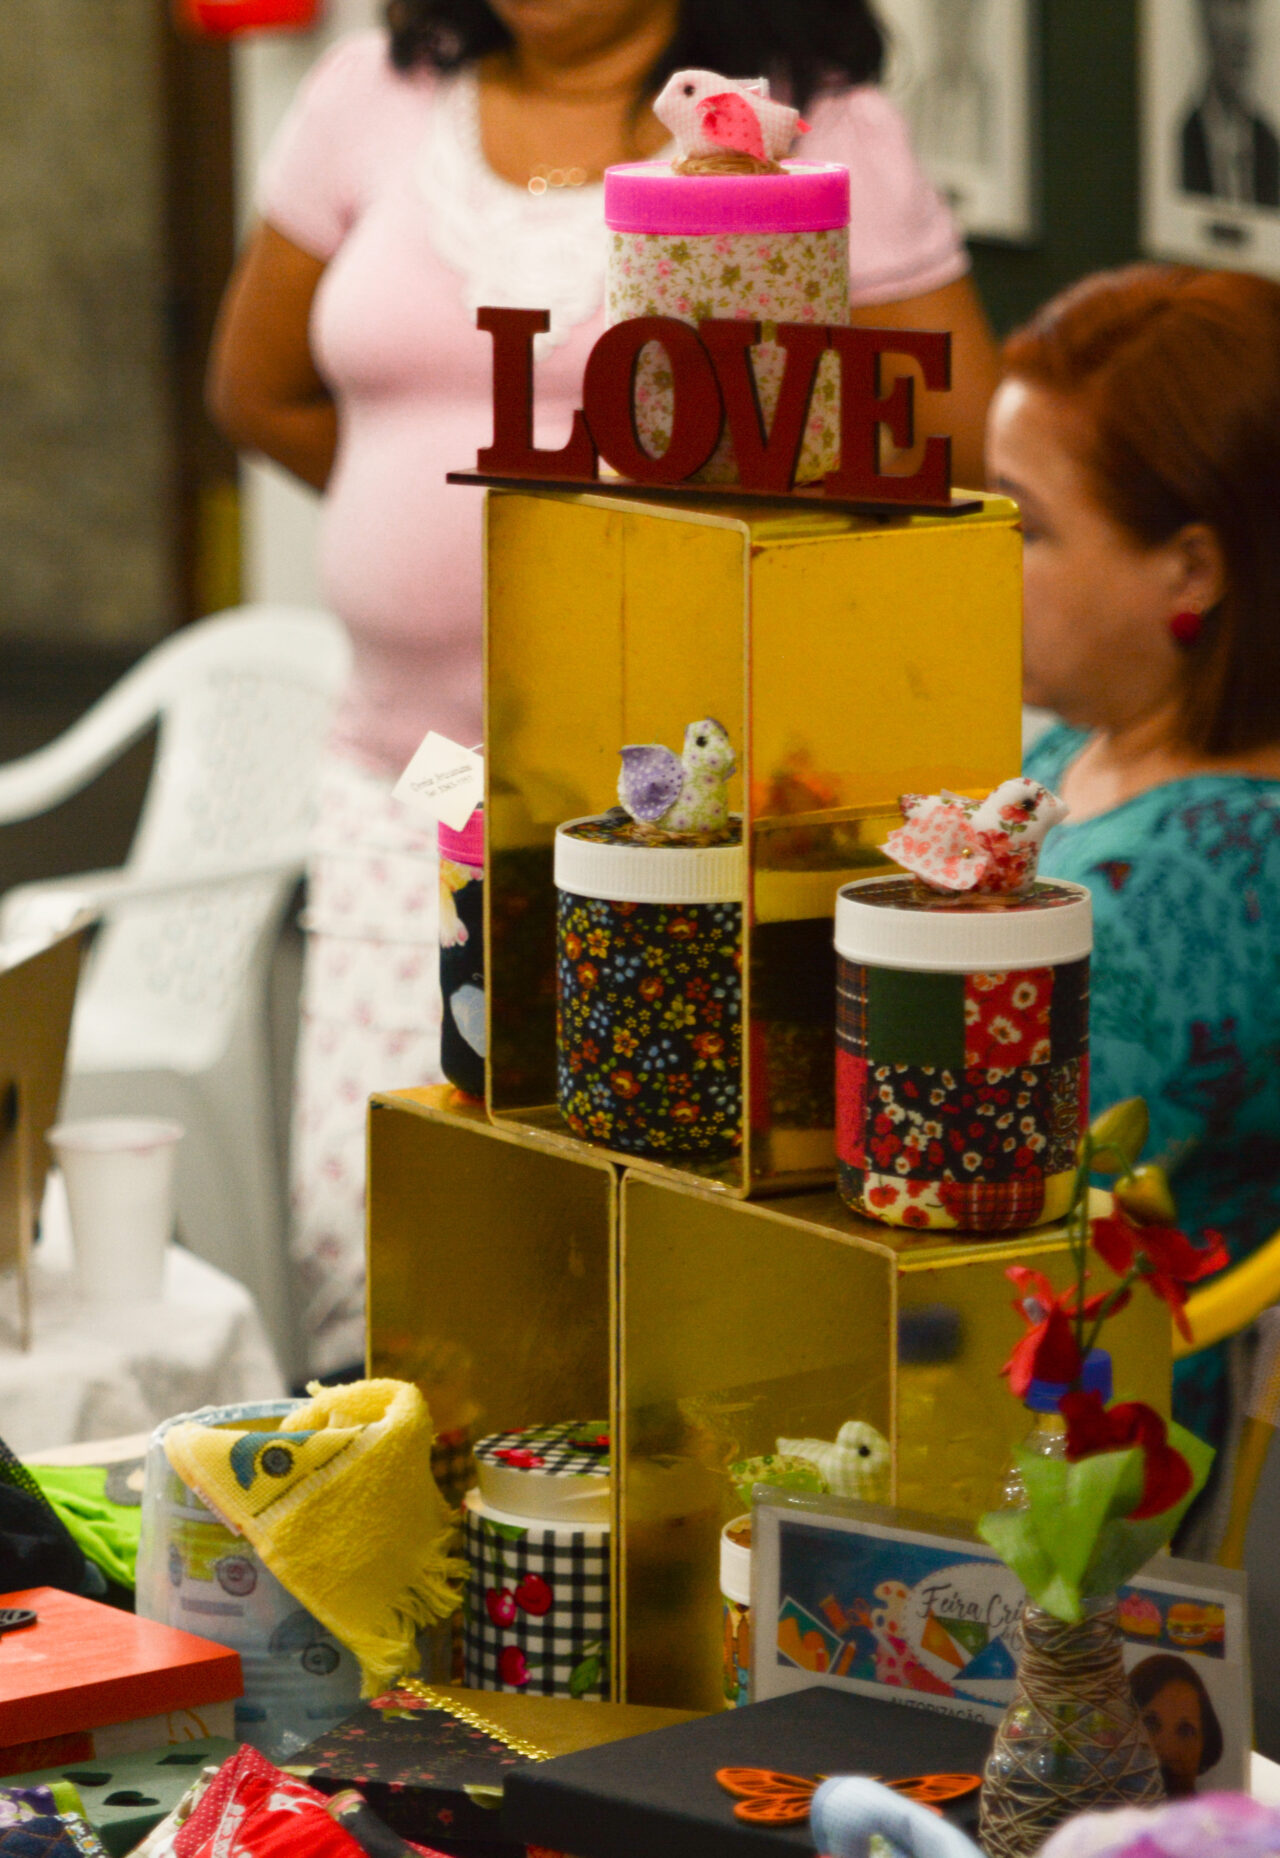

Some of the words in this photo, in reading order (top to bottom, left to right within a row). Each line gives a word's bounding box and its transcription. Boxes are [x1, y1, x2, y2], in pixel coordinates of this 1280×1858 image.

[476, 306, 952, 505] LOVE
[918, 1583, 982, 1621] Feira
[986, 1593, 1025, 1628] Cri
